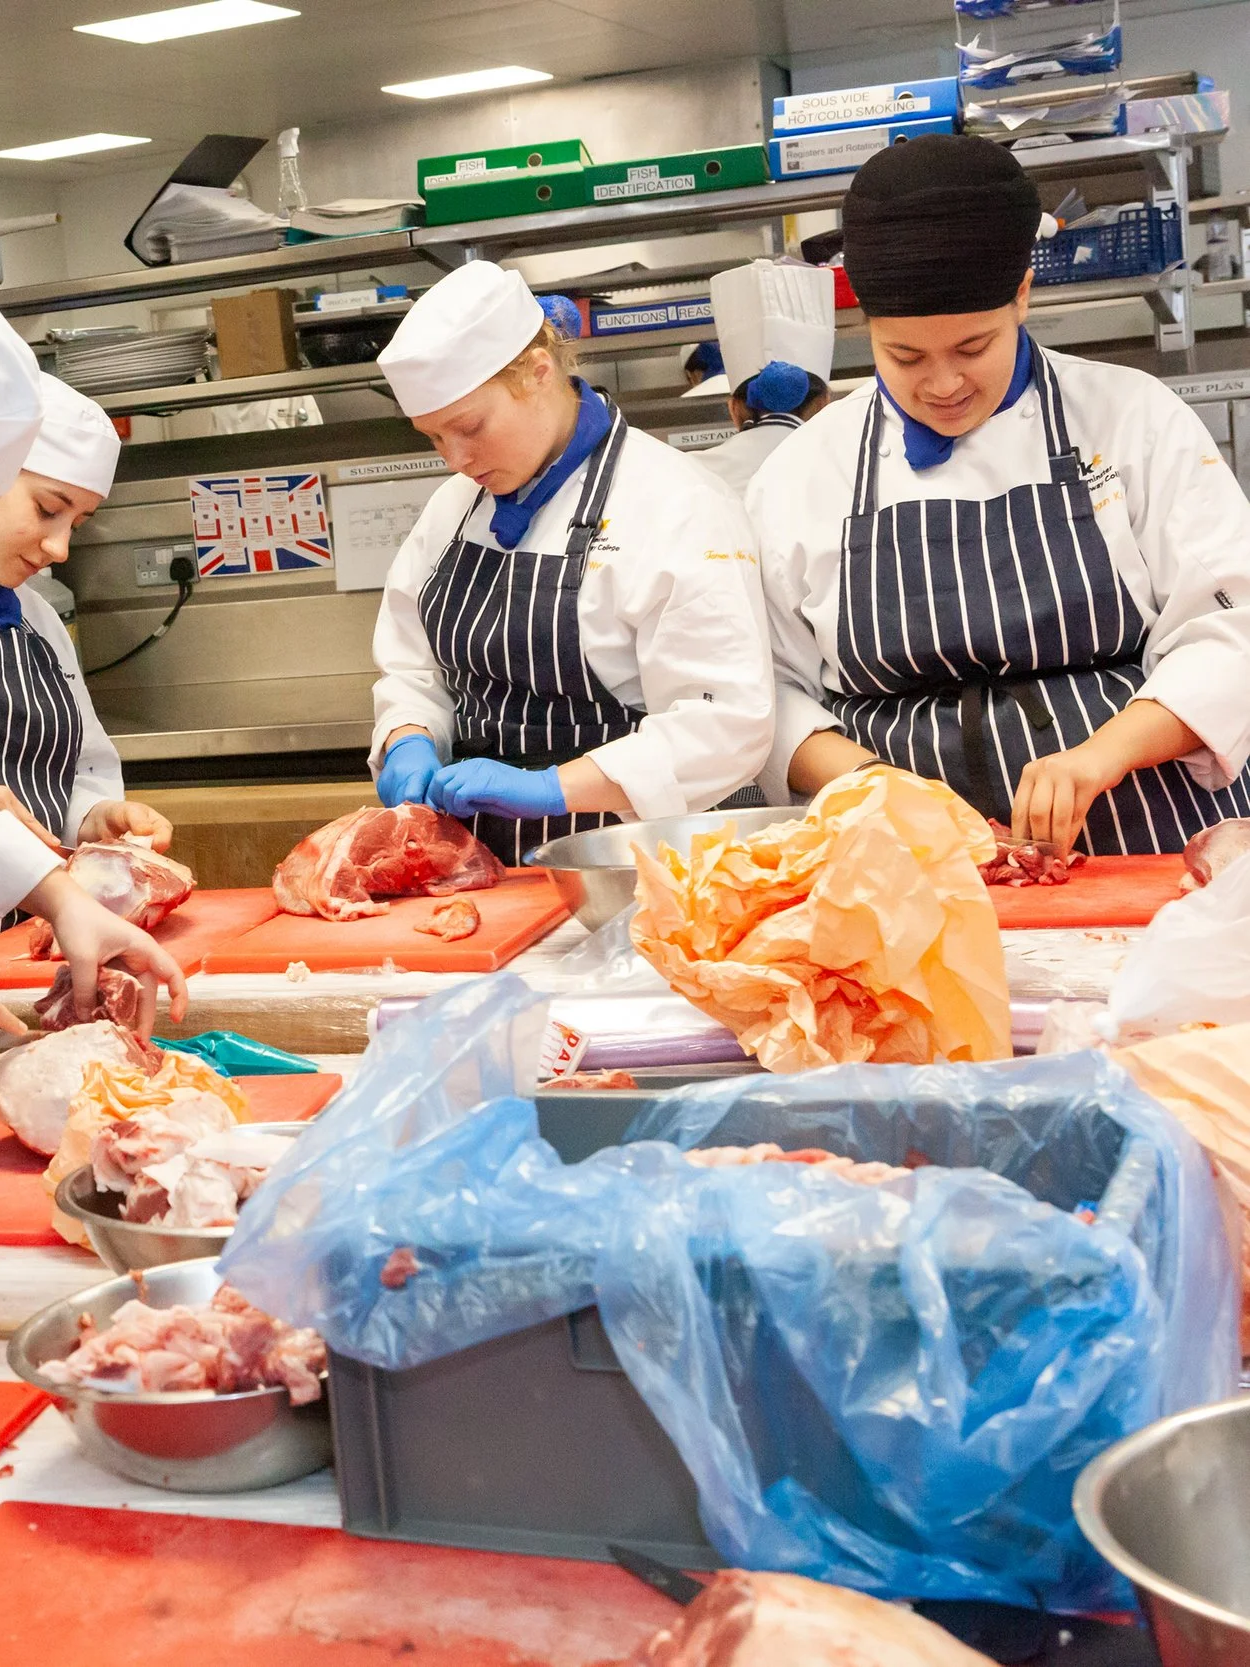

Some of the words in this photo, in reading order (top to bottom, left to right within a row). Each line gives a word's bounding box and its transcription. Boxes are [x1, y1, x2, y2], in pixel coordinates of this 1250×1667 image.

[802, 96, 839, 109] SOUS
[841, 91, 870, 104] VIDE
[788, 109, 852, 125] HOT/COLD
[856, 101, 916, 117] SMOKING
[786, 147, 825, 159] Registers
[827, 144, 844, 154] and
[846, 141, 886, 152] Rotations
[458, 159, 484, 171] FISH
[629, 167, 658, 181] FISH
[596, 177, 693, 197] IDENTIFICATION
[598, 312, 667, 327] FUNCTIONS
[1206, 381, 1244, 393] PLAN
[350, 460, 447, 476] SUSTAINABILITY
